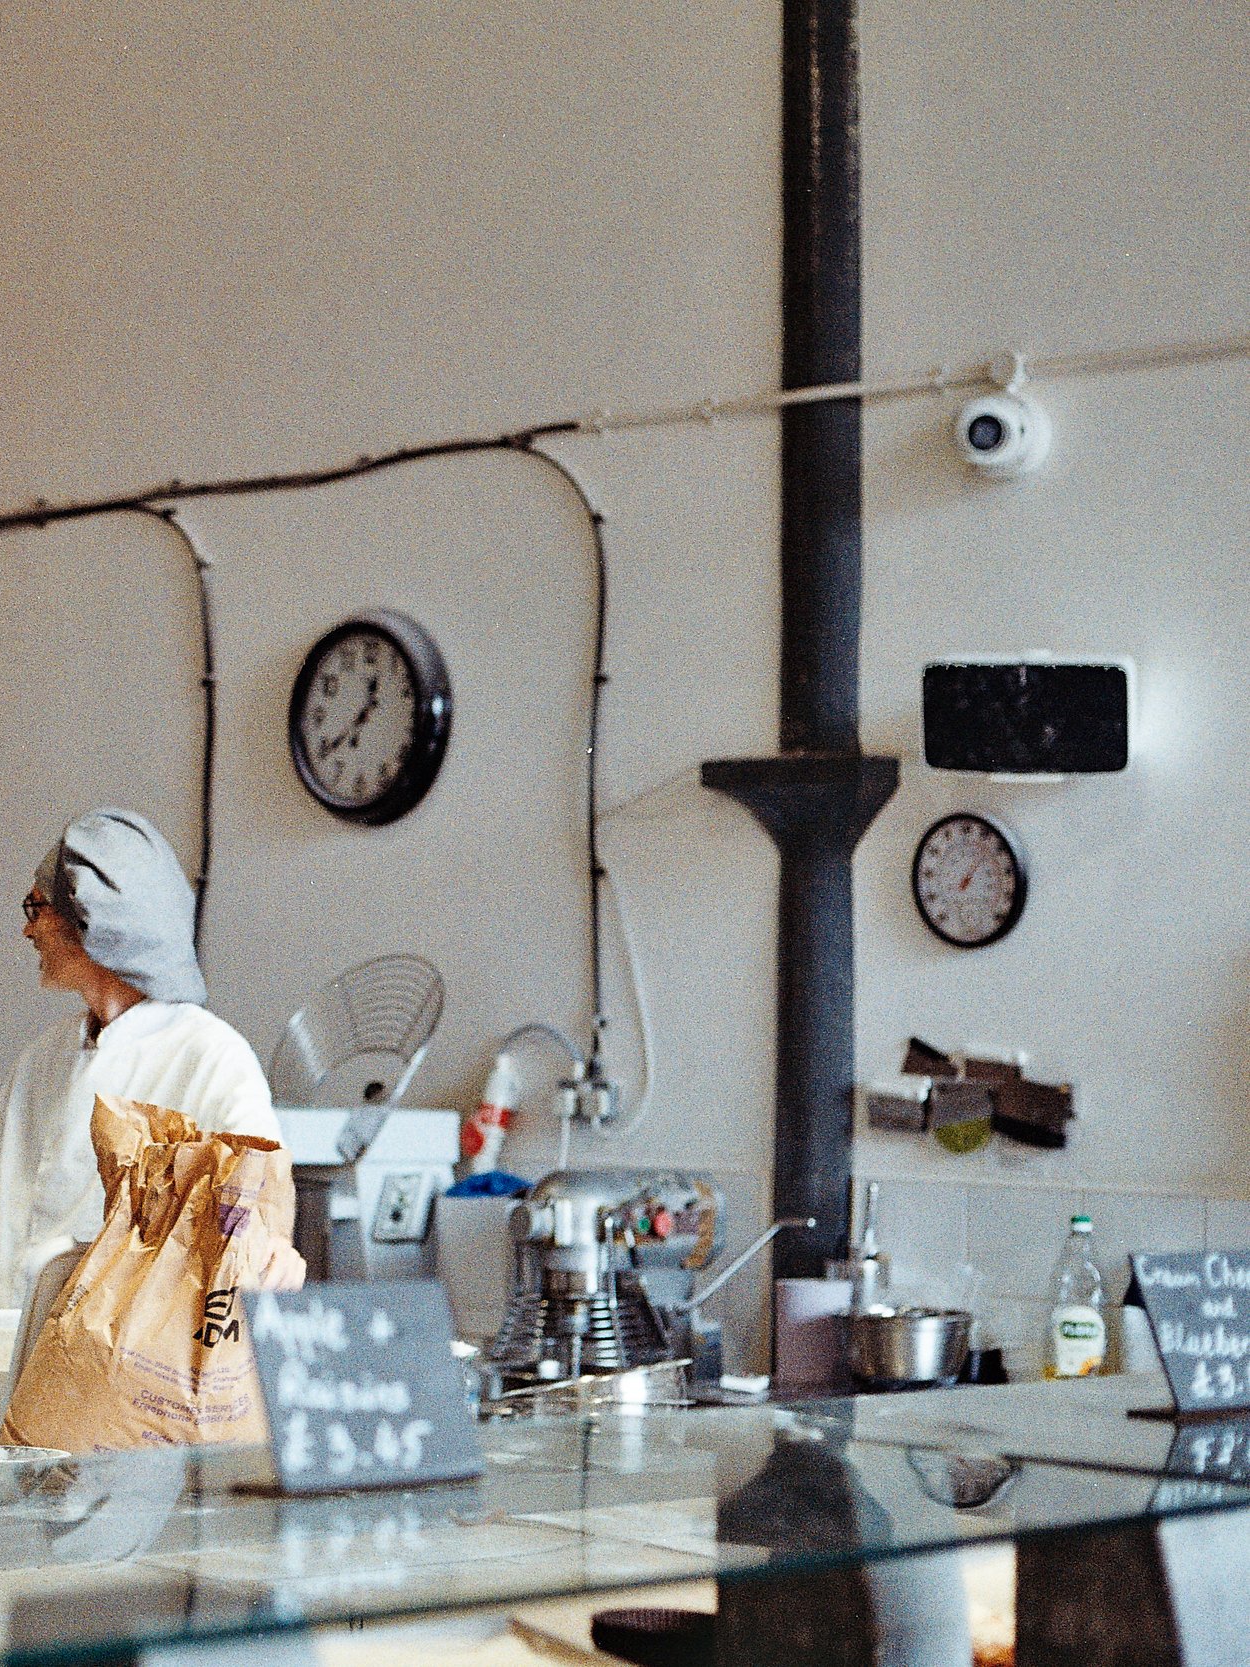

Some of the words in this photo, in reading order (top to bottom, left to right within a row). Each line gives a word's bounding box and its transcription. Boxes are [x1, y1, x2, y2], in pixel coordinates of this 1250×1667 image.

[1134, 1254, 1201, 1288] Cream
[1202, 1296, 1238, 1320] and
[1191, 1361, 1250, 1400] £3.
